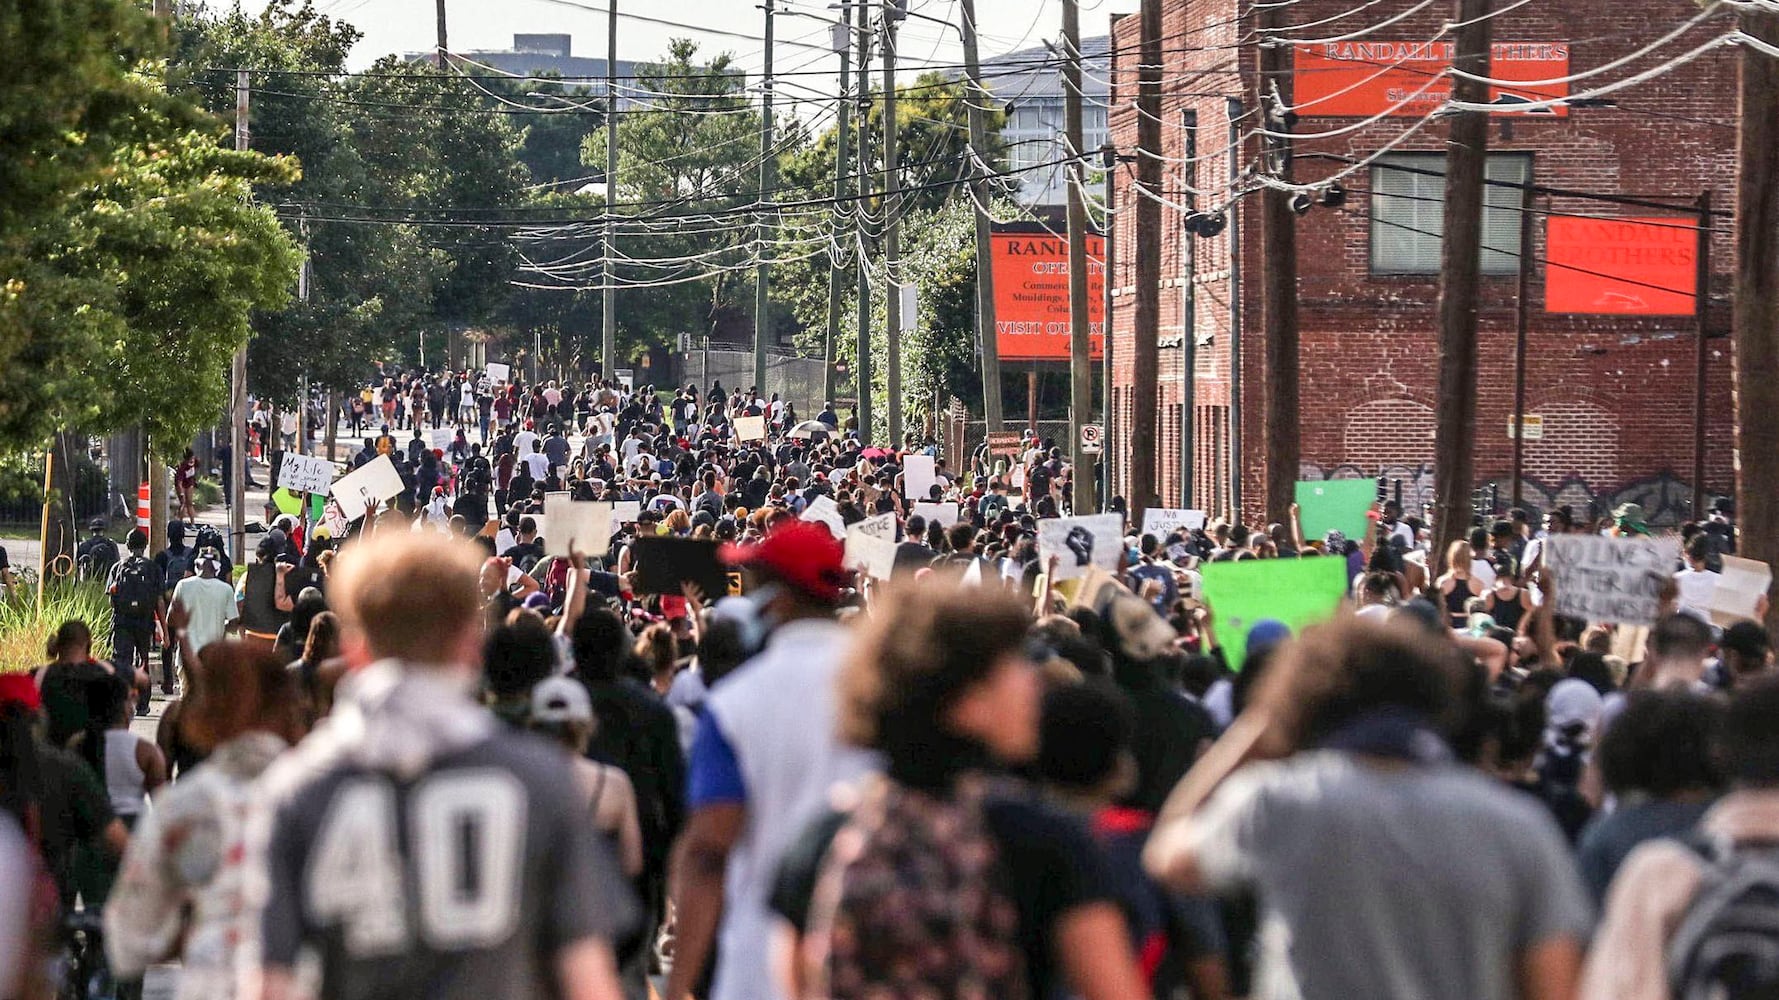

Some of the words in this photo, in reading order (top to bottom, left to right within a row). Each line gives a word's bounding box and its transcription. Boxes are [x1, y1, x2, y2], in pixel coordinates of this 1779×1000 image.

[1324, 43, 1438, 61] RANDALL
[996, 321, 1042, 335] VISIT
[284, 457, 299, 474] My
[305, 767, 527, 957] 40
